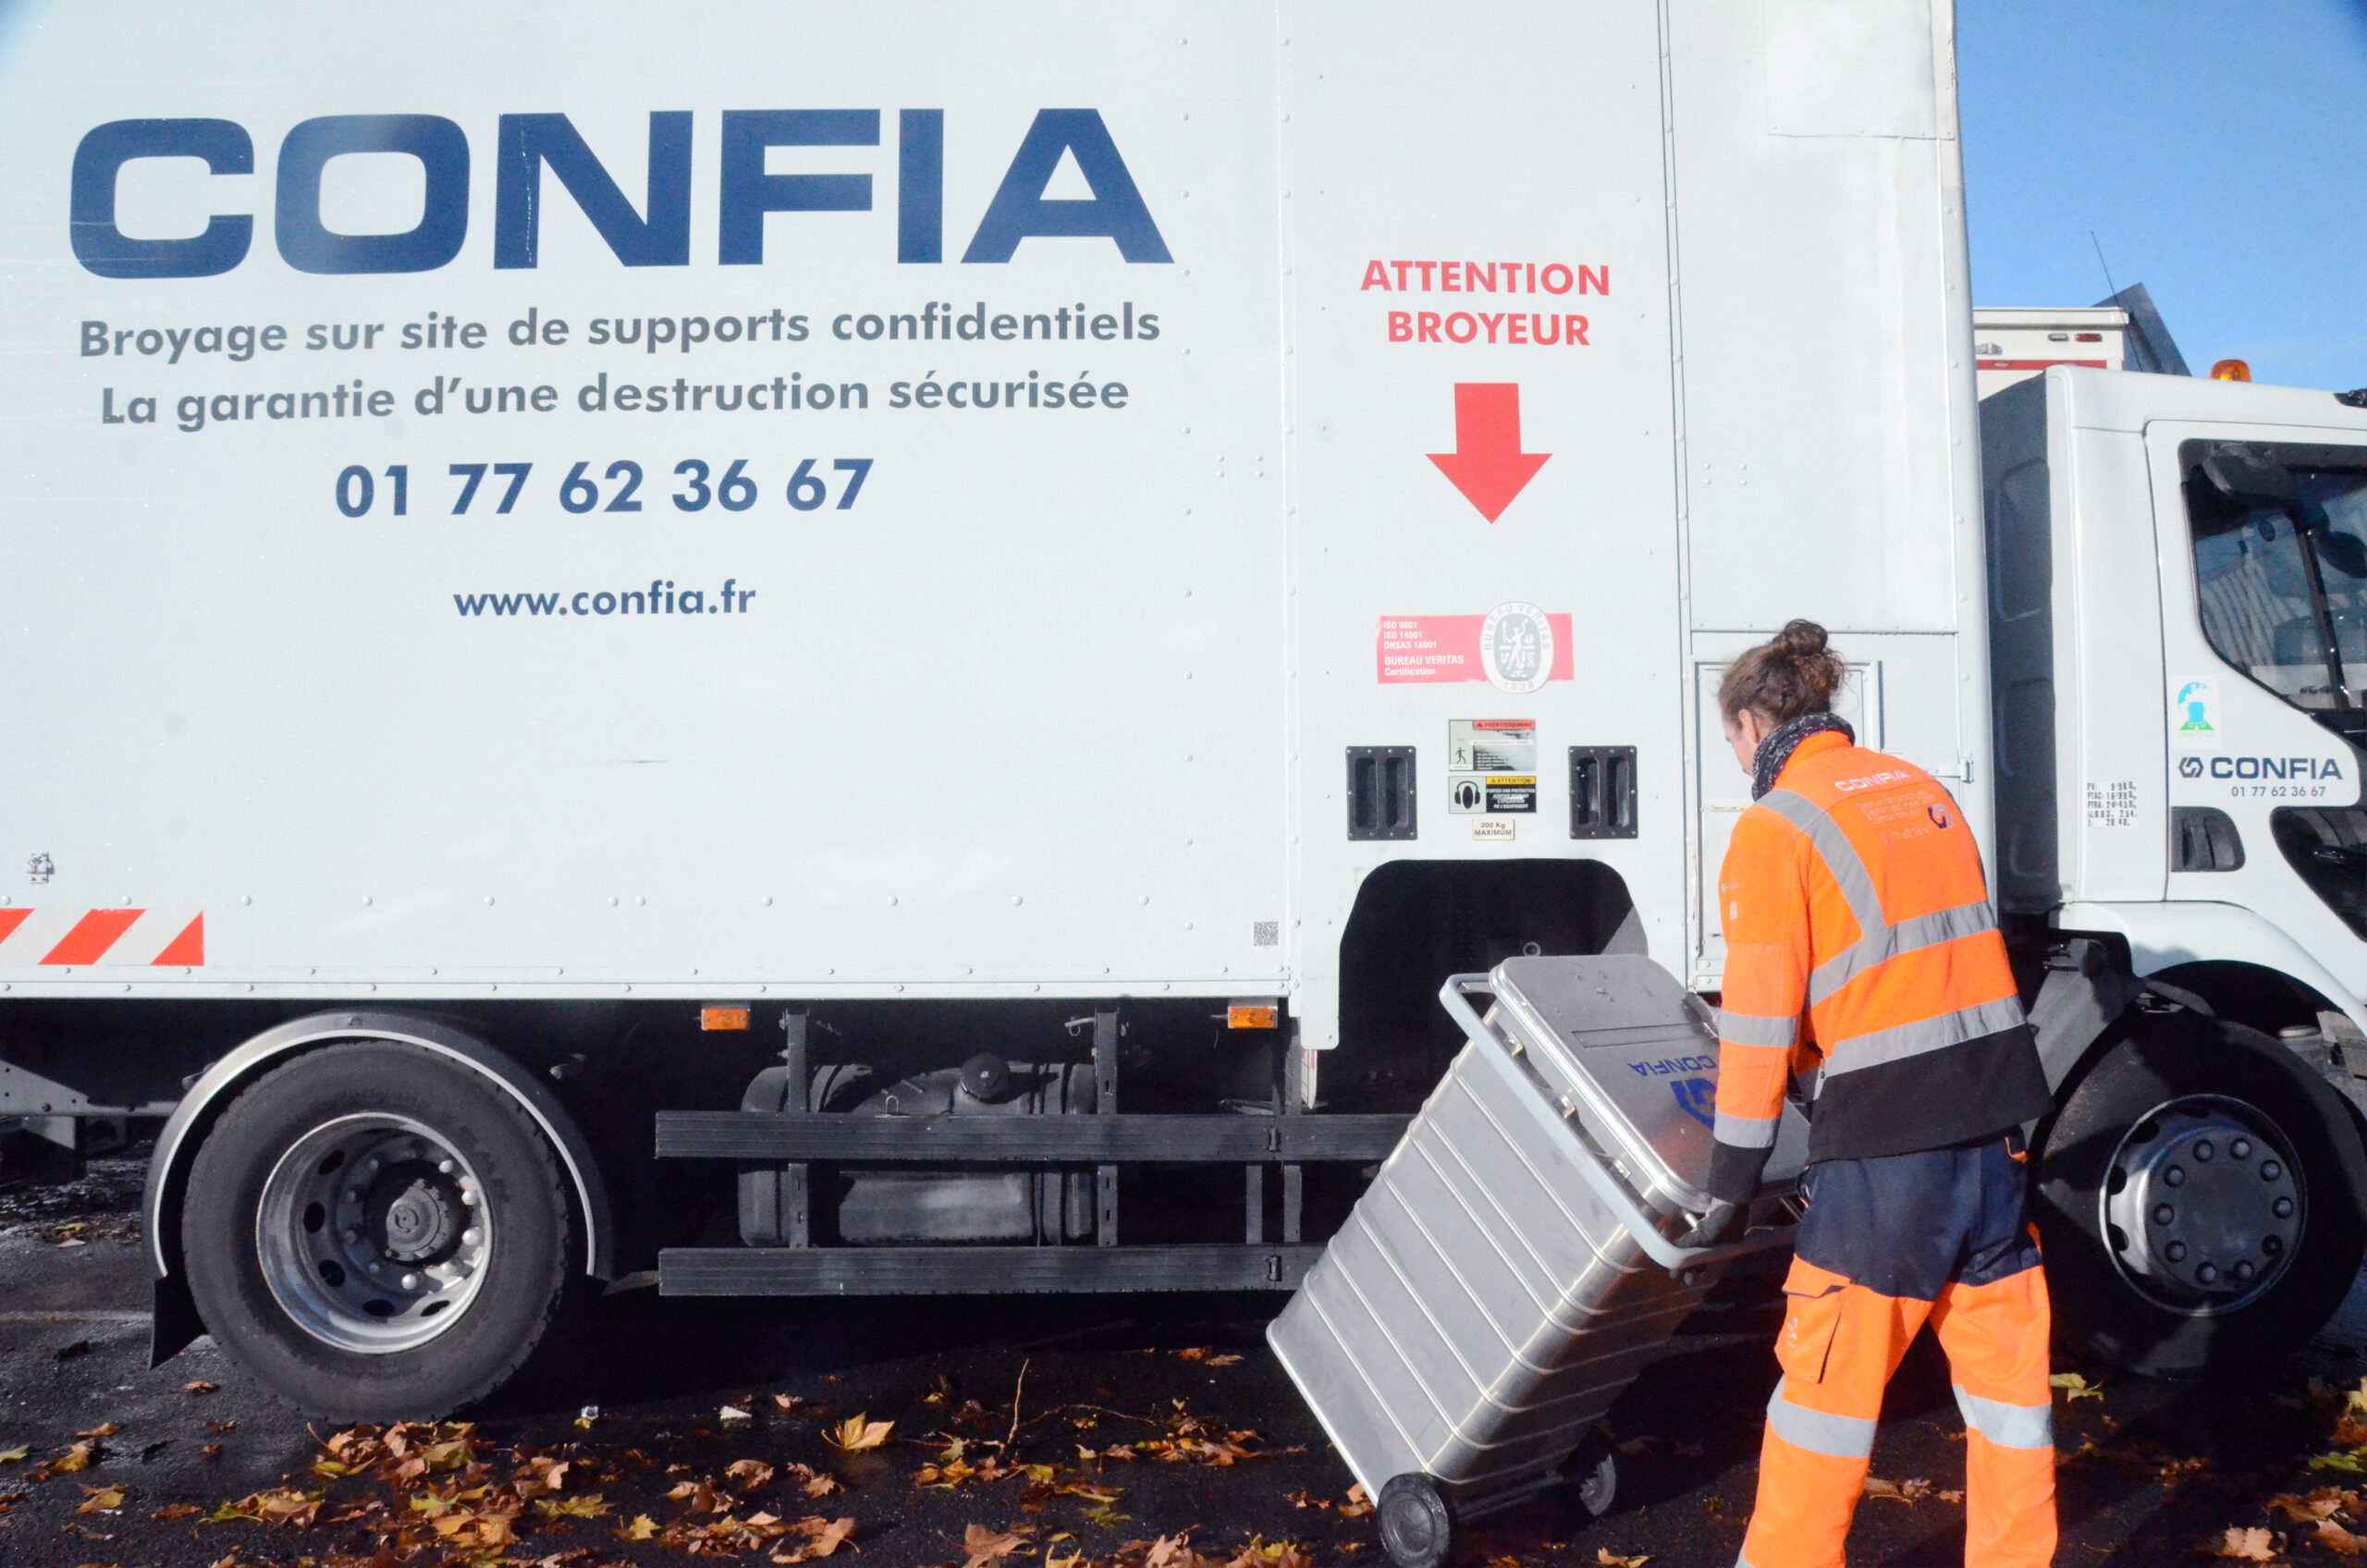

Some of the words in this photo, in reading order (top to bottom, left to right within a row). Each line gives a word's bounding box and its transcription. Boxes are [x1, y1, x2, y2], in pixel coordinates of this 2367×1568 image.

[70, 108, 1173, 279] CONFIA
[1360, 260, 1610, 296] ATTENTION
[80, 320, 288, 365] Broyage
[305, 323, 385, 351] sur
[400, 311, 487, 349] site
[508, 307, 570, 347] de
[587, 308, 810, 354] supports
[831, 301, 1160, 341] confidentiels
[1389, 312, 1590, 346] BROYEUR
[102, 386, 157, 424] La
[177, 378, 396, 433] garantie
[577, 372, 868, 413] destruction
[889, 369, 1129, 410] sécurisée
[335, 464, 408, 519] 01
[448, 462, 533, 515] 77
[558, 460, 644, 514] 62
[672, 459, 758, 513] 36
[786, 458, 874, 511] 67
[452, 578, 756, 617] www.confia.fr
[1383, 620, 1397, 630] ISO
[1399, 620, 1417, 630] 9001
[1383, 631, 1397, 640] ISO
[1400, 631, 1423, 640] 14001
[1484, 604, 1513, 651] BUREAU
[1518, 604, 1551, 650] VERITAS
[1384, 641, 1412, 650] OHSAS
[1414, 640, 1438, 650] 18001
[1384, 655, 1423, 666] BUREAU
[1427, 654, 1465, 666] VERITAS
[1384, 666, 1436, 677] Certification
[1834, 769, 1910, 791] CONFIA
[2210, 756, 2343, 780] CONFIA
[2231, 786, 2245, 798] 01
[2251, 786, 2267, 797] 77
[2270, 785, 2287, 798] 62
[2290, 786, 2307, 797] 36
[2311, 785, 2326, 798] 67
[1496, 821, 1506, 829] Kg
[1626, 1055, 1718, 1077] CONFIA
